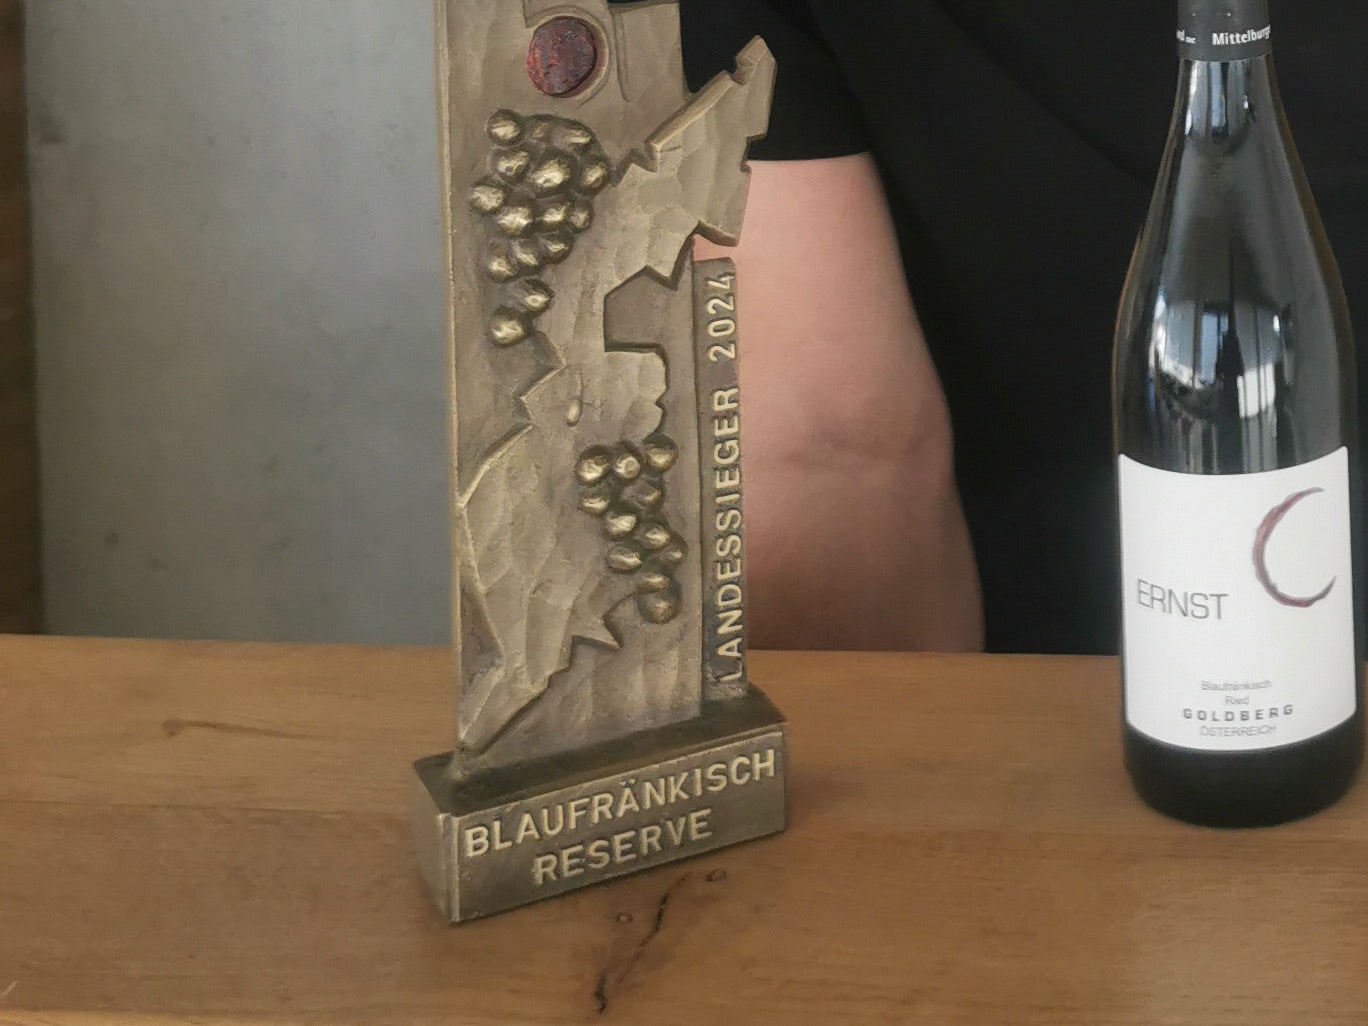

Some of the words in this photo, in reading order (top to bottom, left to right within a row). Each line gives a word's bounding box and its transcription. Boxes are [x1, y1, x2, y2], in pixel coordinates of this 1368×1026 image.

[707, 274, 736, 362] 2024
[714, 387, 744, 682] LANDESSIEGER
[1137, 578, 1228, 619] ERNST
[1183, 704, 1293, 722] GOLDBERG
[464, 749, 775, 858] BLAUFRÄNKISCH
[532, 808, 713, 886] RESERVE
